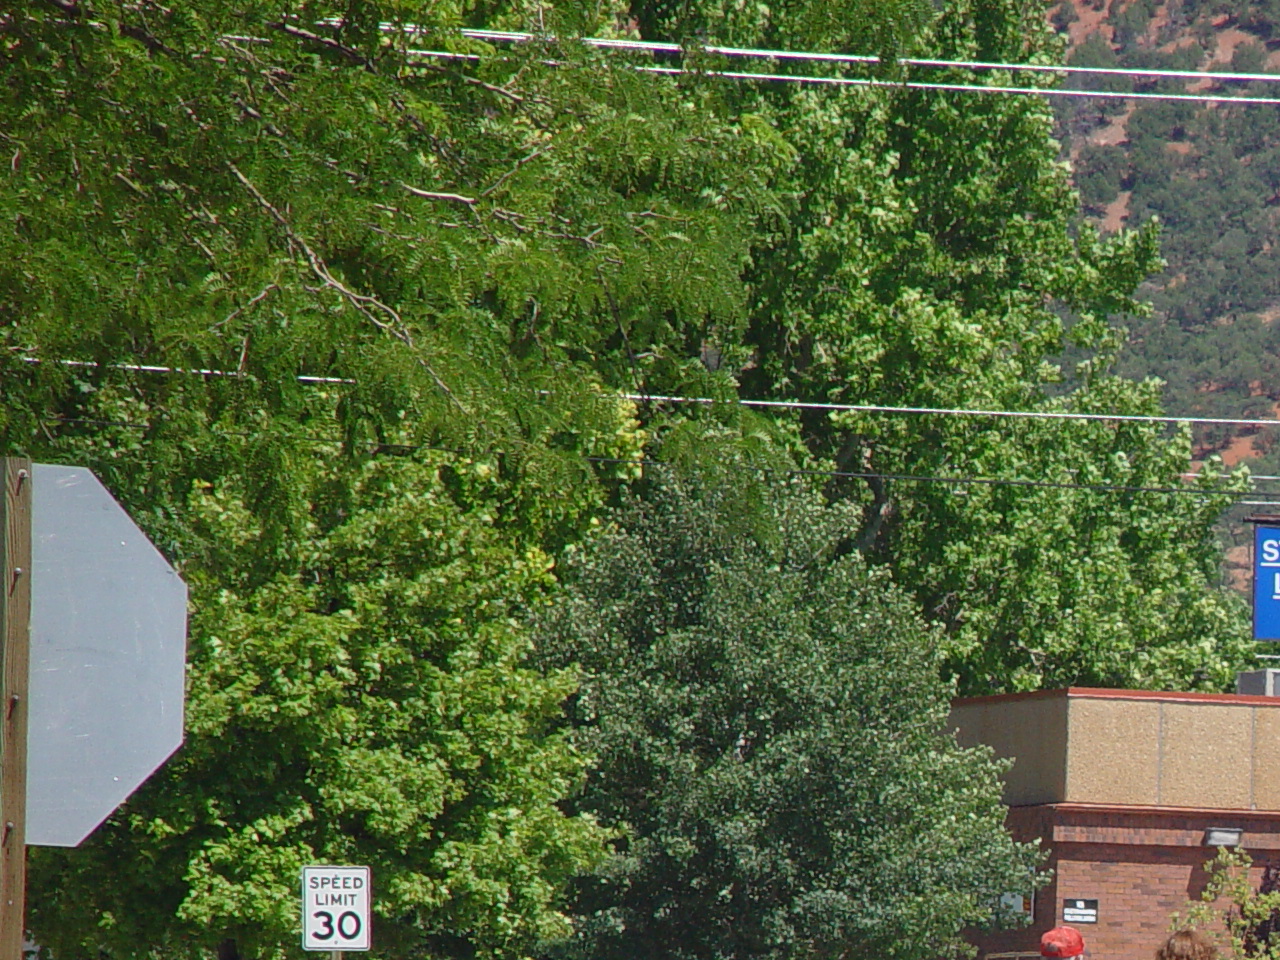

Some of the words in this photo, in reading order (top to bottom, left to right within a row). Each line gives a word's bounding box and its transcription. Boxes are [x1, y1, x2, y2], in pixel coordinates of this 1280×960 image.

[309, 876, 364, 889] SPEED
[315, 893, 358, 906] LIMIT
[311, 910, 362, 940] 30
